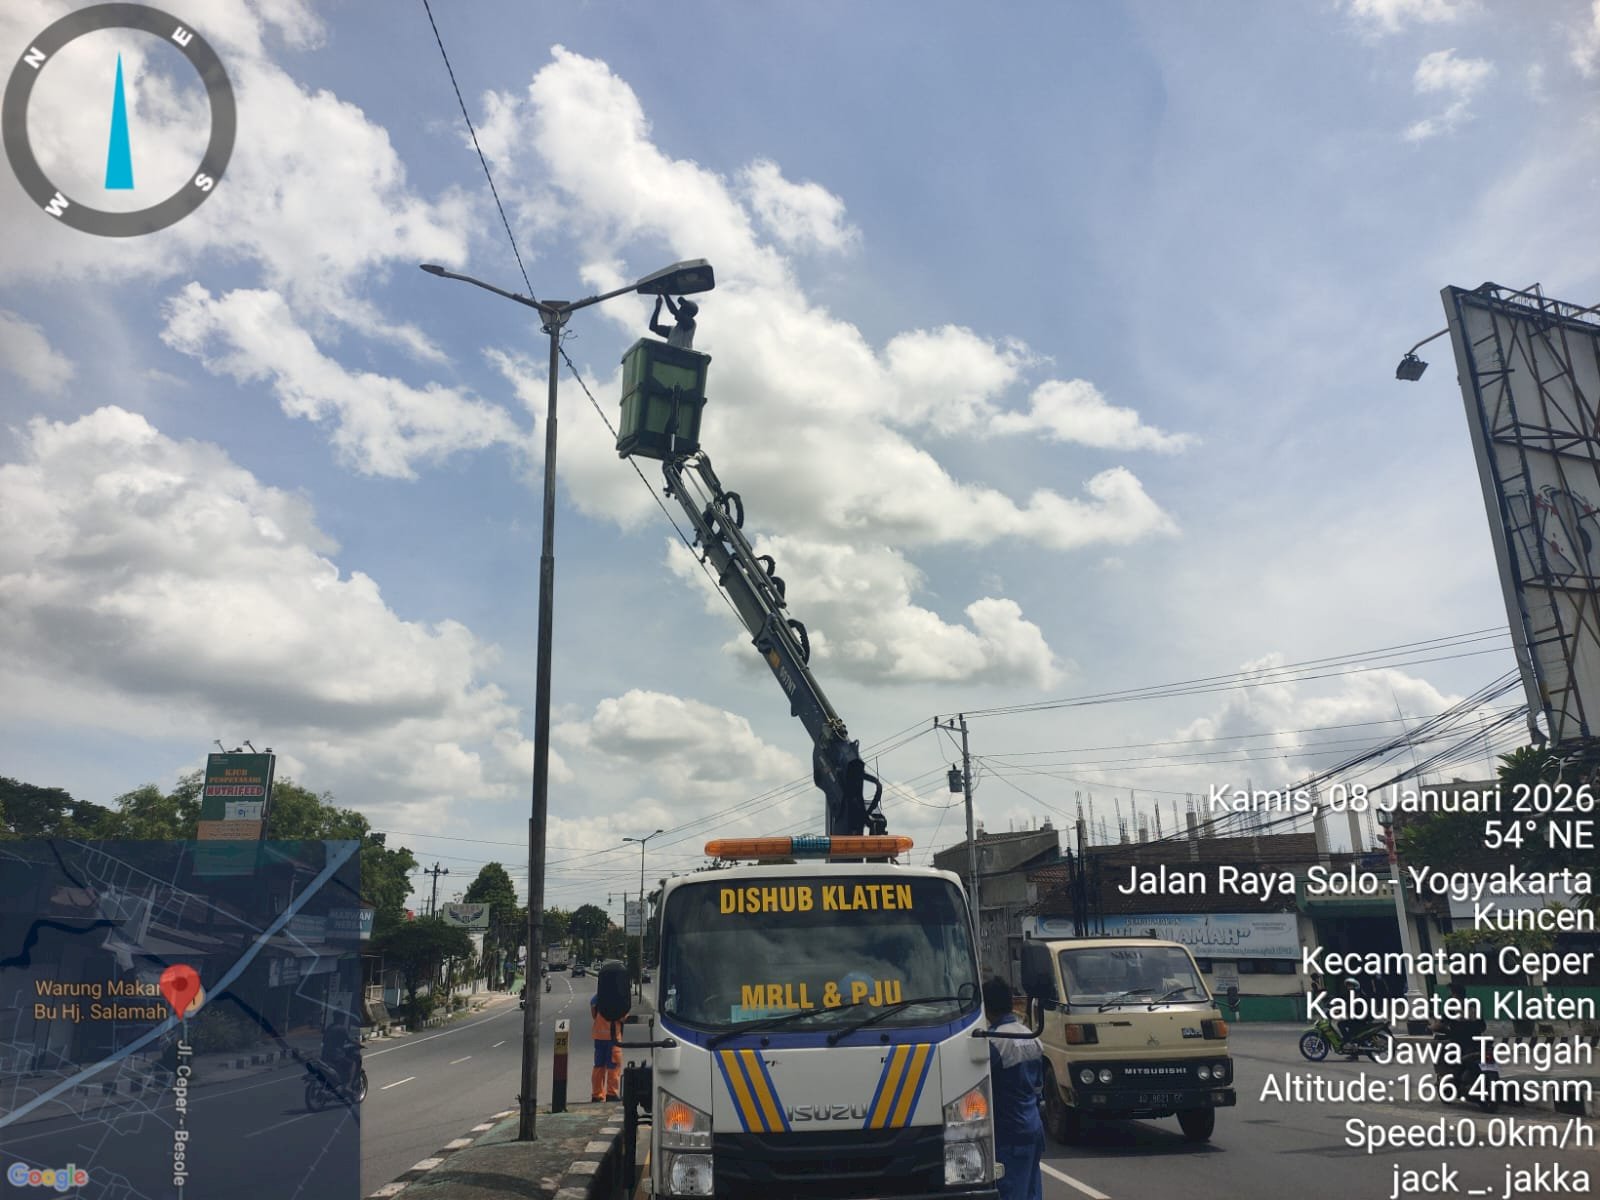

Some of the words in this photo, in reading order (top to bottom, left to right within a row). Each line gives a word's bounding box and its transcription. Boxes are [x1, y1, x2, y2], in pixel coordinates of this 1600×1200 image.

[206, 785, 263, 796] NUTRIFEED
[720, 886, 814, 914] DISHUB
[821, 884, 913, 911] KLATEN
[741, 983, 814, 1010] MRLL
[823, 981, 842, 1008] &
[851, 979, 903, 1007] PJU
[558, 1020, 566, 1030] 4
[1124, 1067, 1187, 1075] MITSUBISHI
[786, 1104, 868, 1121] ISUZU
